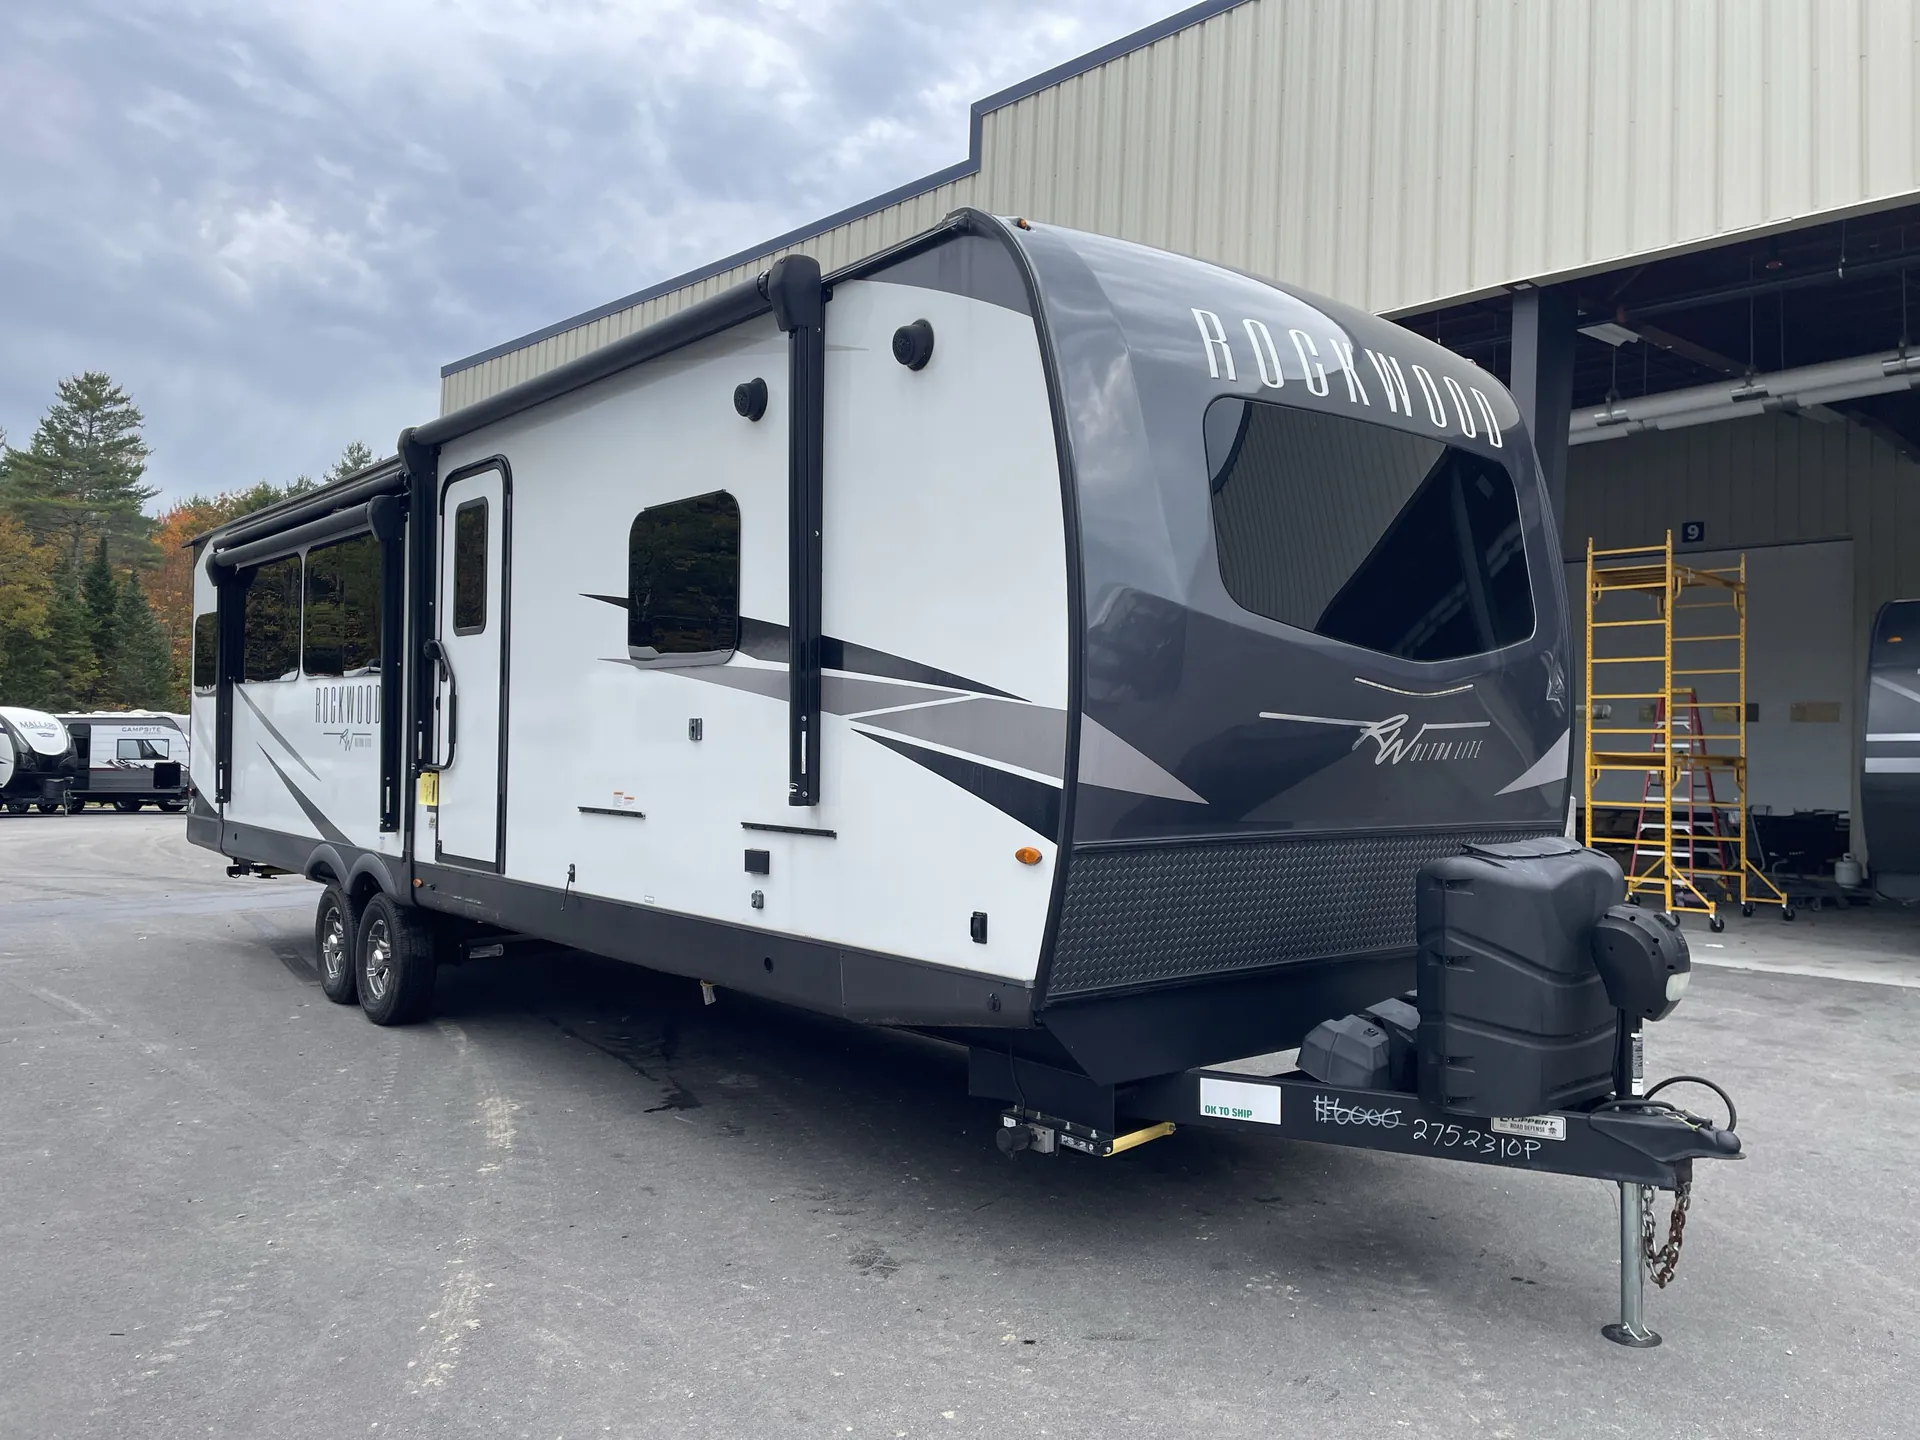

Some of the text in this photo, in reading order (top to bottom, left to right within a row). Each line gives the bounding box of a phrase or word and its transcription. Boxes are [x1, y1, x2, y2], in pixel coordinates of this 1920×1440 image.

[1190, 307, 1503, 449] ROCKWOOD
[1687, 524, 1700, 540] 9
[315, 685, 381, 724] ROCKWOOD
[1410, 743, 1452, 762] ULTRA
[1454, 740, 1484, 760] LITE
[1204, 1104, 1253, 1118] OK TO SHIP
[1510, 1122, 1524, 1130] ROAD
[1524, 1124, 1546, 1133] DEFENSE
[1413, 1119, 1542, 1160] 2752310P
